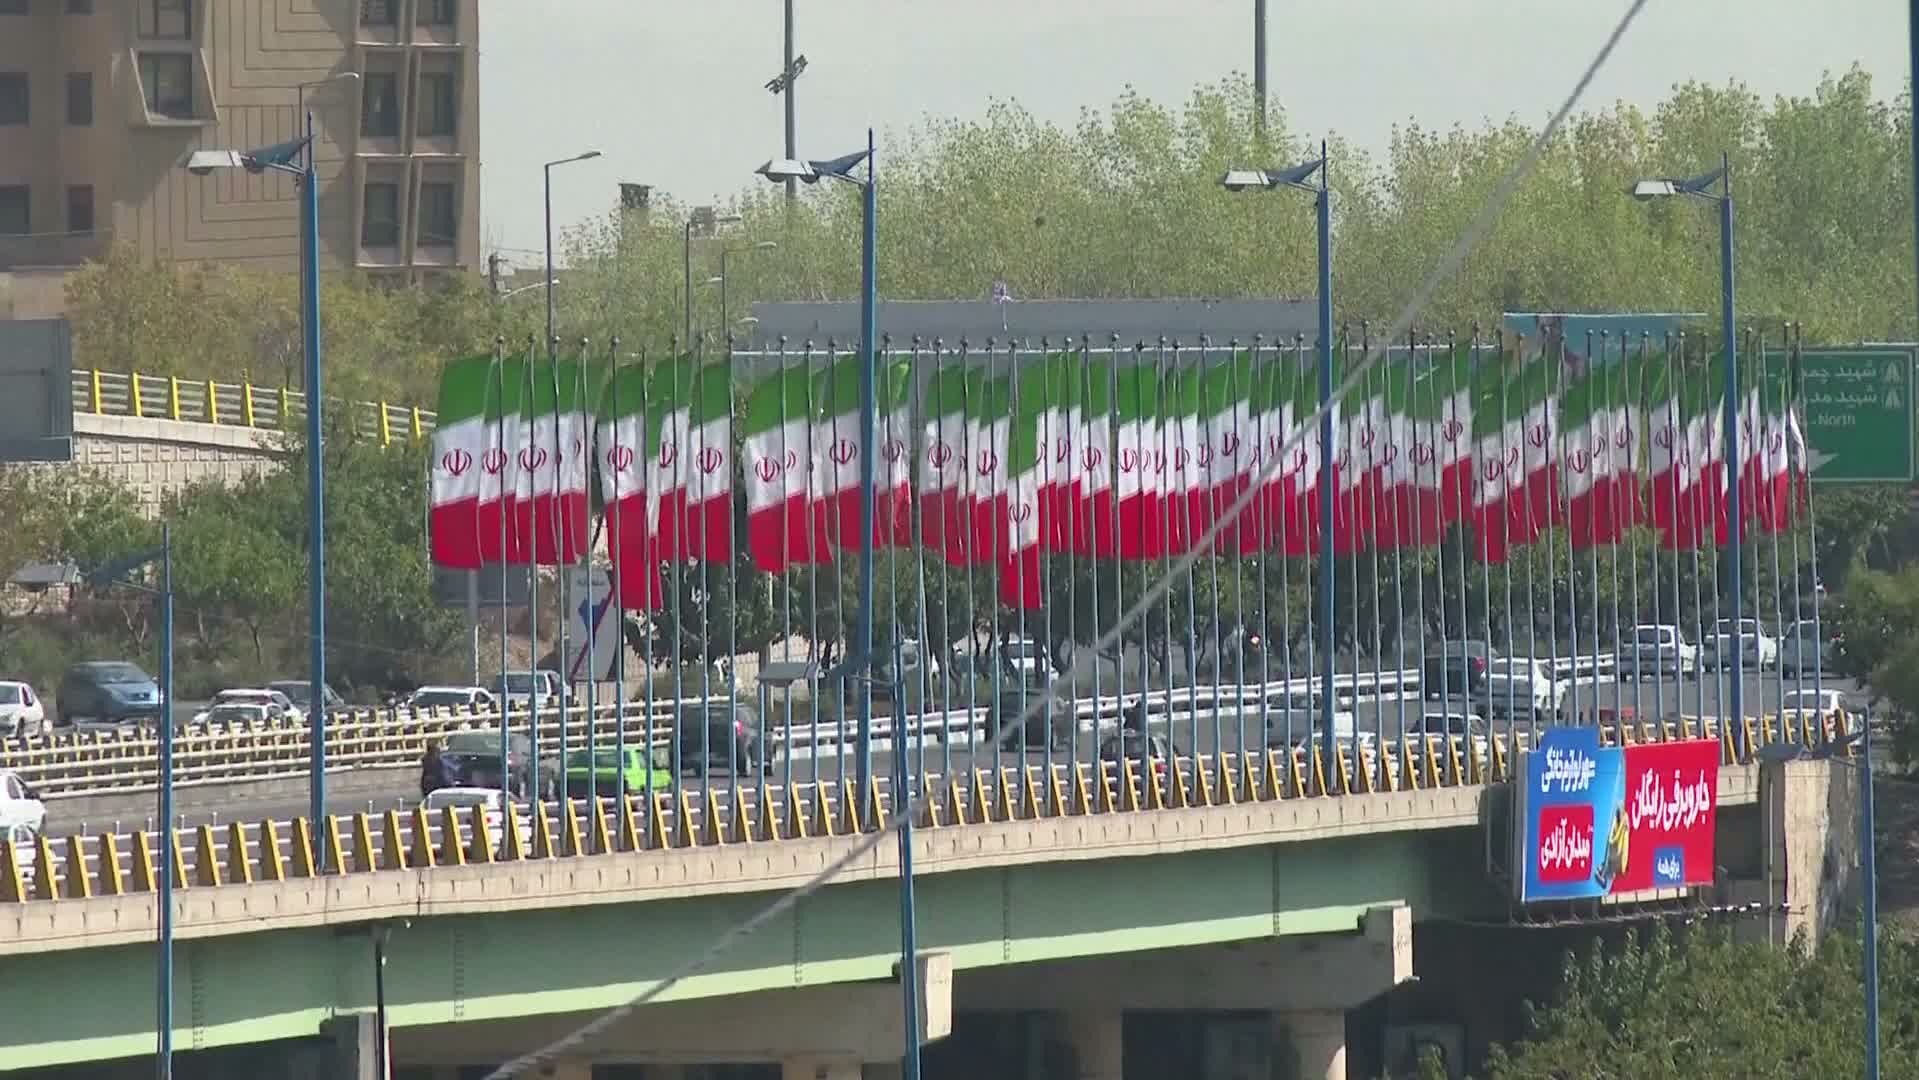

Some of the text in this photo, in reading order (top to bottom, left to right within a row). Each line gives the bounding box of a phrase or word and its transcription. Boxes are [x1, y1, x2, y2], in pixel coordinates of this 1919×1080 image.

[1632, 767, 1664, 831] رایگان
[1541, 817, 1590, 869] میدان آزادی
